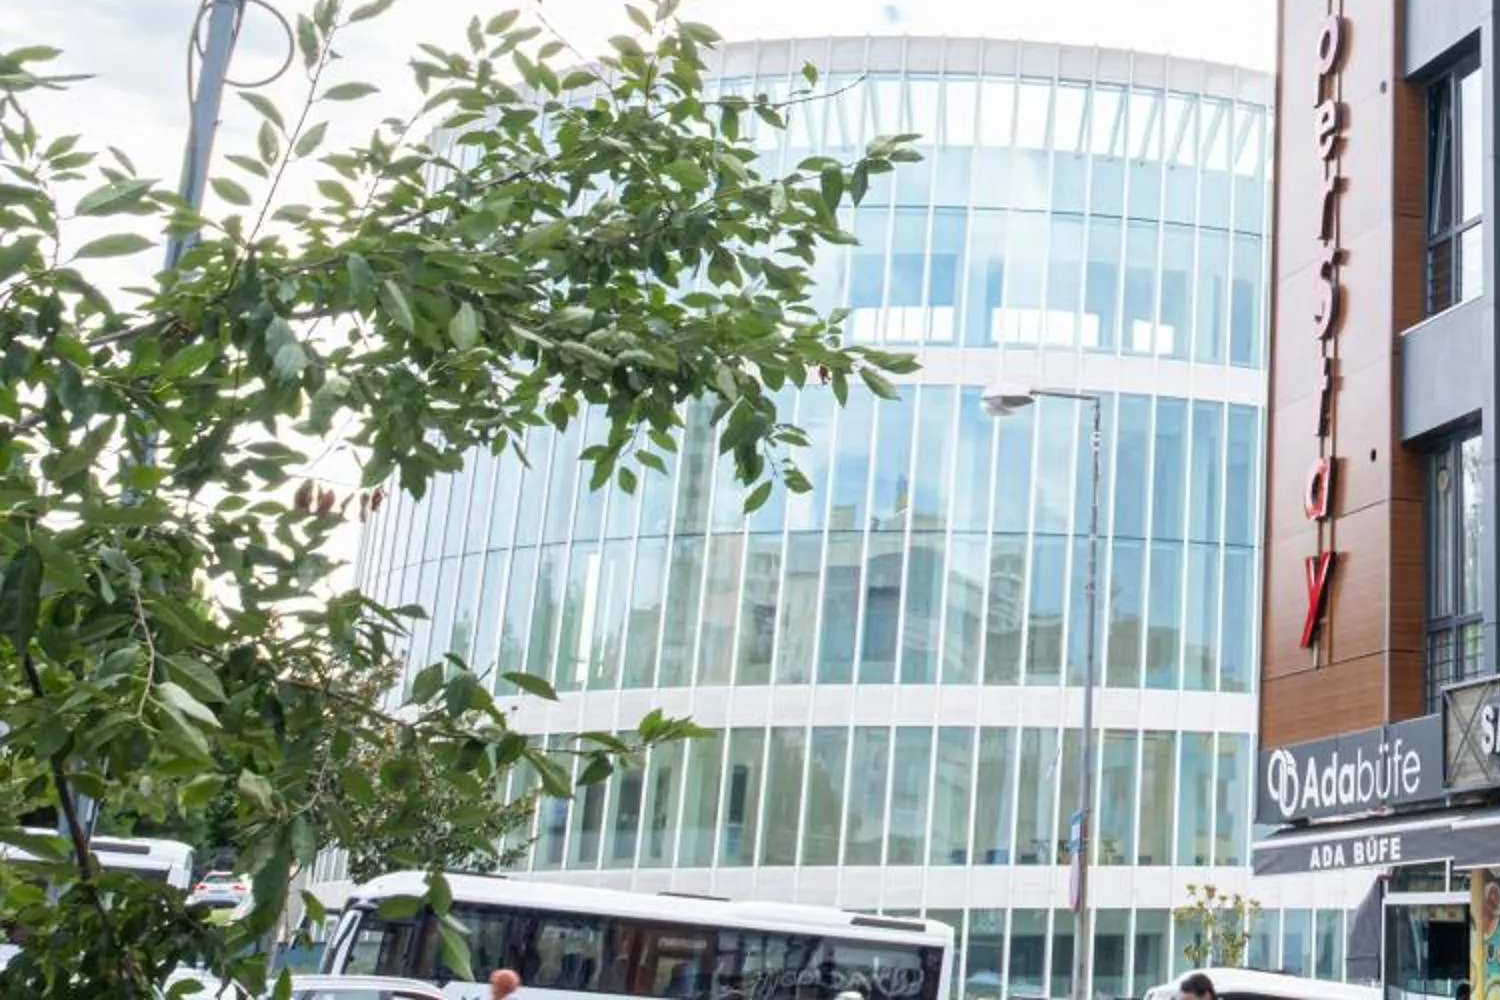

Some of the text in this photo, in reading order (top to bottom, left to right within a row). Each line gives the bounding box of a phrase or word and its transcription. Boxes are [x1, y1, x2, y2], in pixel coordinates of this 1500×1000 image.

[1301, 739, 1421, 809] Adabüfe
[1309, 836, 1402, 869] ADA BÜFE
